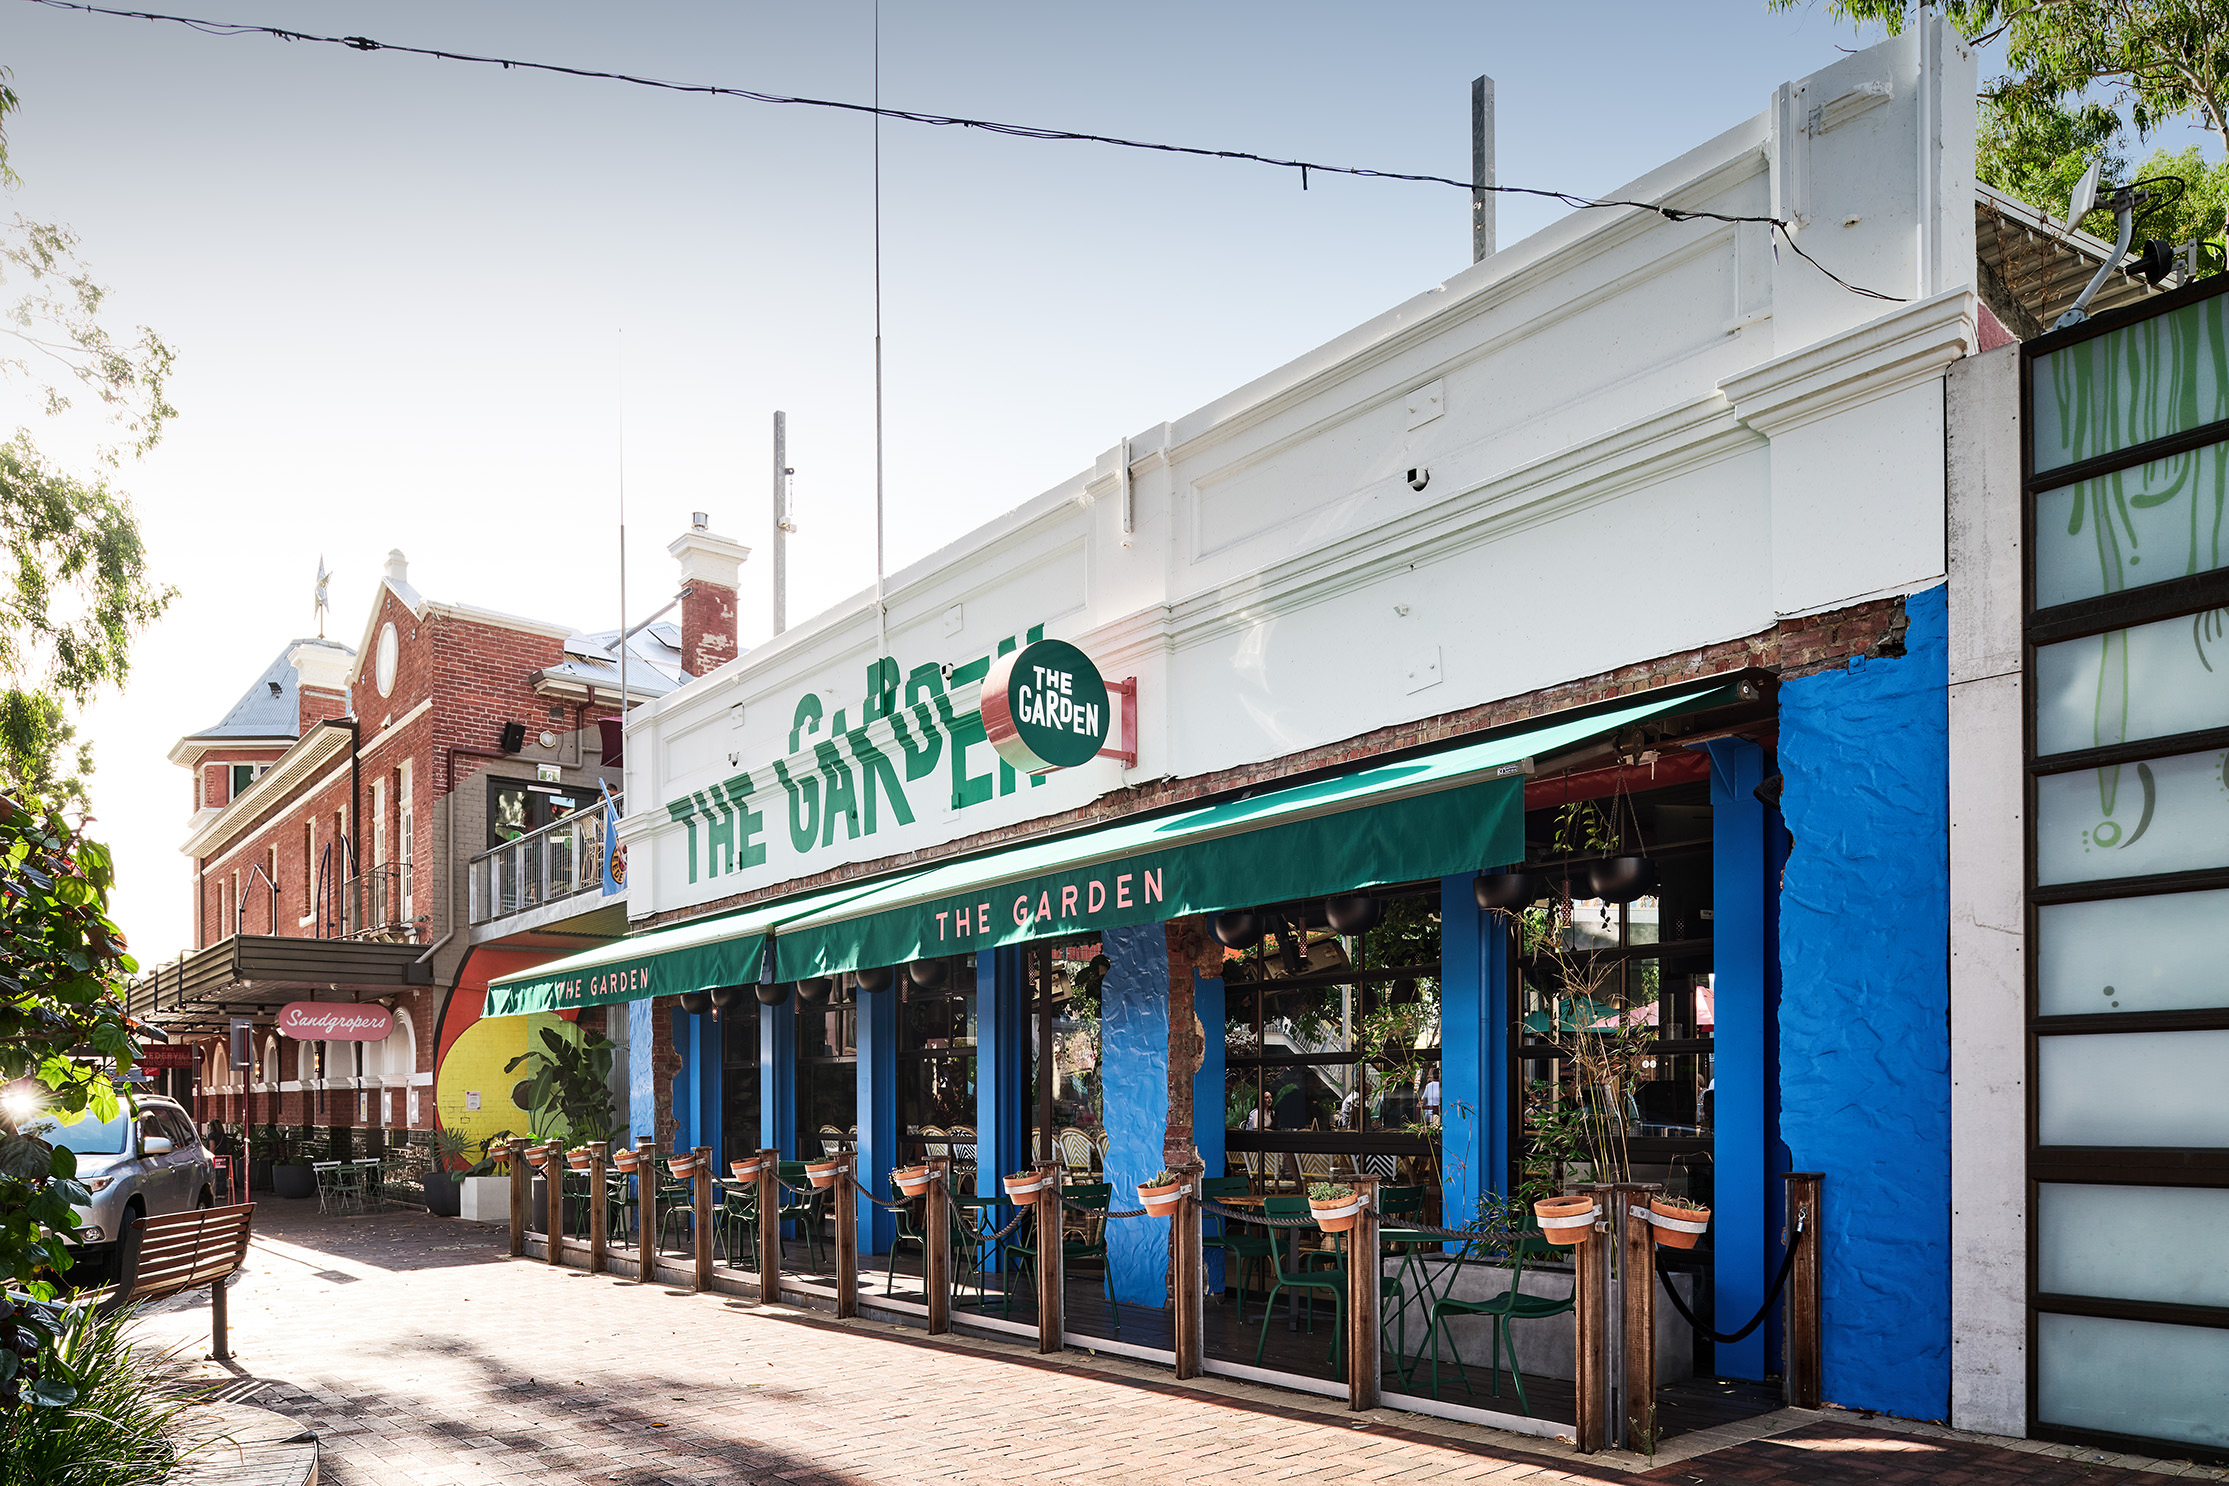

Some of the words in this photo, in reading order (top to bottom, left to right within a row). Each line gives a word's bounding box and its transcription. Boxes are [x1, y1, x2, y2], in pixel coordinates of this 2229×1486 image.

[1033, 665, 1073, 696] THE
[1018, 684, 1099, 738] GARDEN
[666, 771, 766, 884] THE
[935, 903, 990, 941] THE
[1012, 867, 1163, 927] GARDEN
[558, 979, 582, 1001] THE
[590, 967, 649, 996] GARDEN
[286, 1009, 386, 1034] Sandgropers
